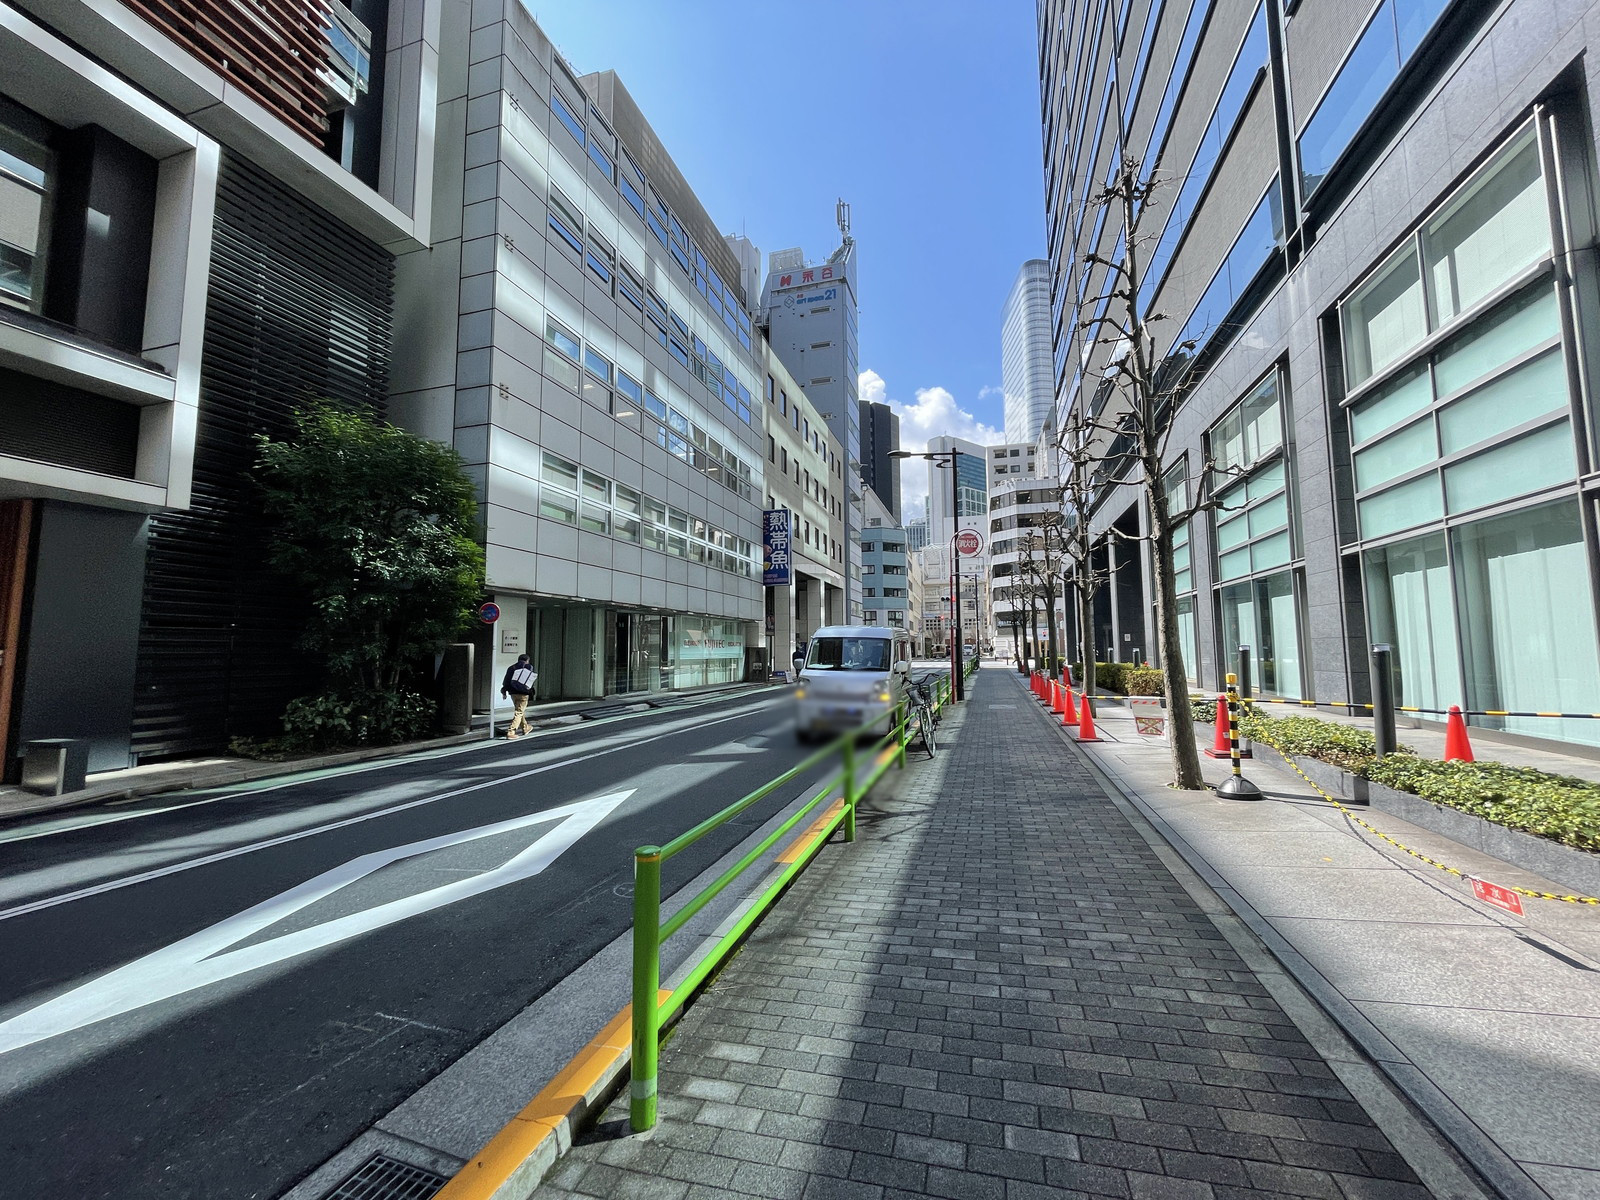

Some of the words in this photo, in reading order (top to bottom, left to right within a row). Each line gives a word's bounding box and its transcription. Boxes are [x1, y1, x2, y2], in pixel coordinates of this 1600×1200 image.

[825, 289, 837, 300] 21
[769, 511, 789, 570] 熱帯魚
[958, 539, 977, 548] 消火栓
